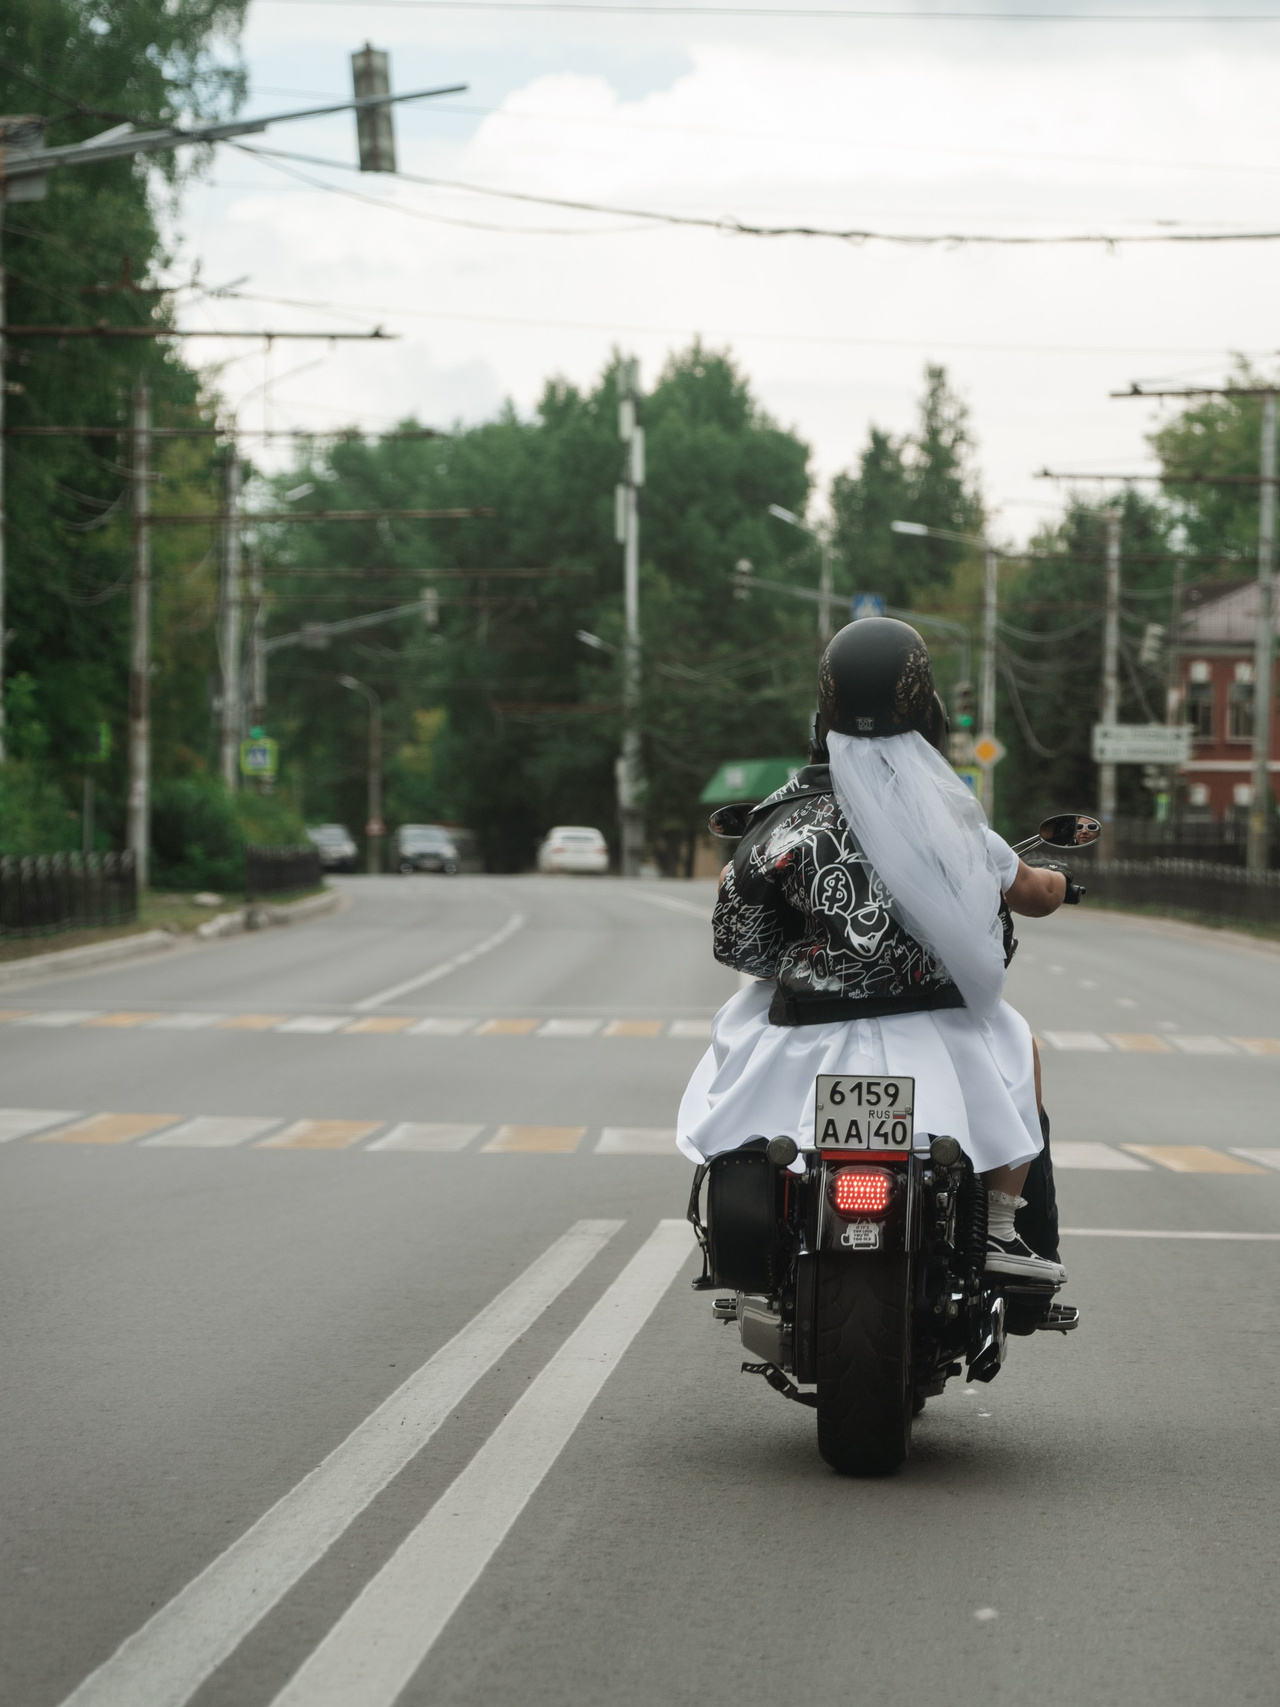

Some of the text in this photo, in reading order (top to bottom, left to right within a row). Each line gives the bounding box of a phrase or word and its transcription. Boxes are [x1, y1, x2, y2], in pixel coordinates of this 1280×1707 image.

[829, 1080, 900, 1107] 6159
[868, 1109, 891, 1120] RUS
[821, 1118, 908, 1145] AA 40
